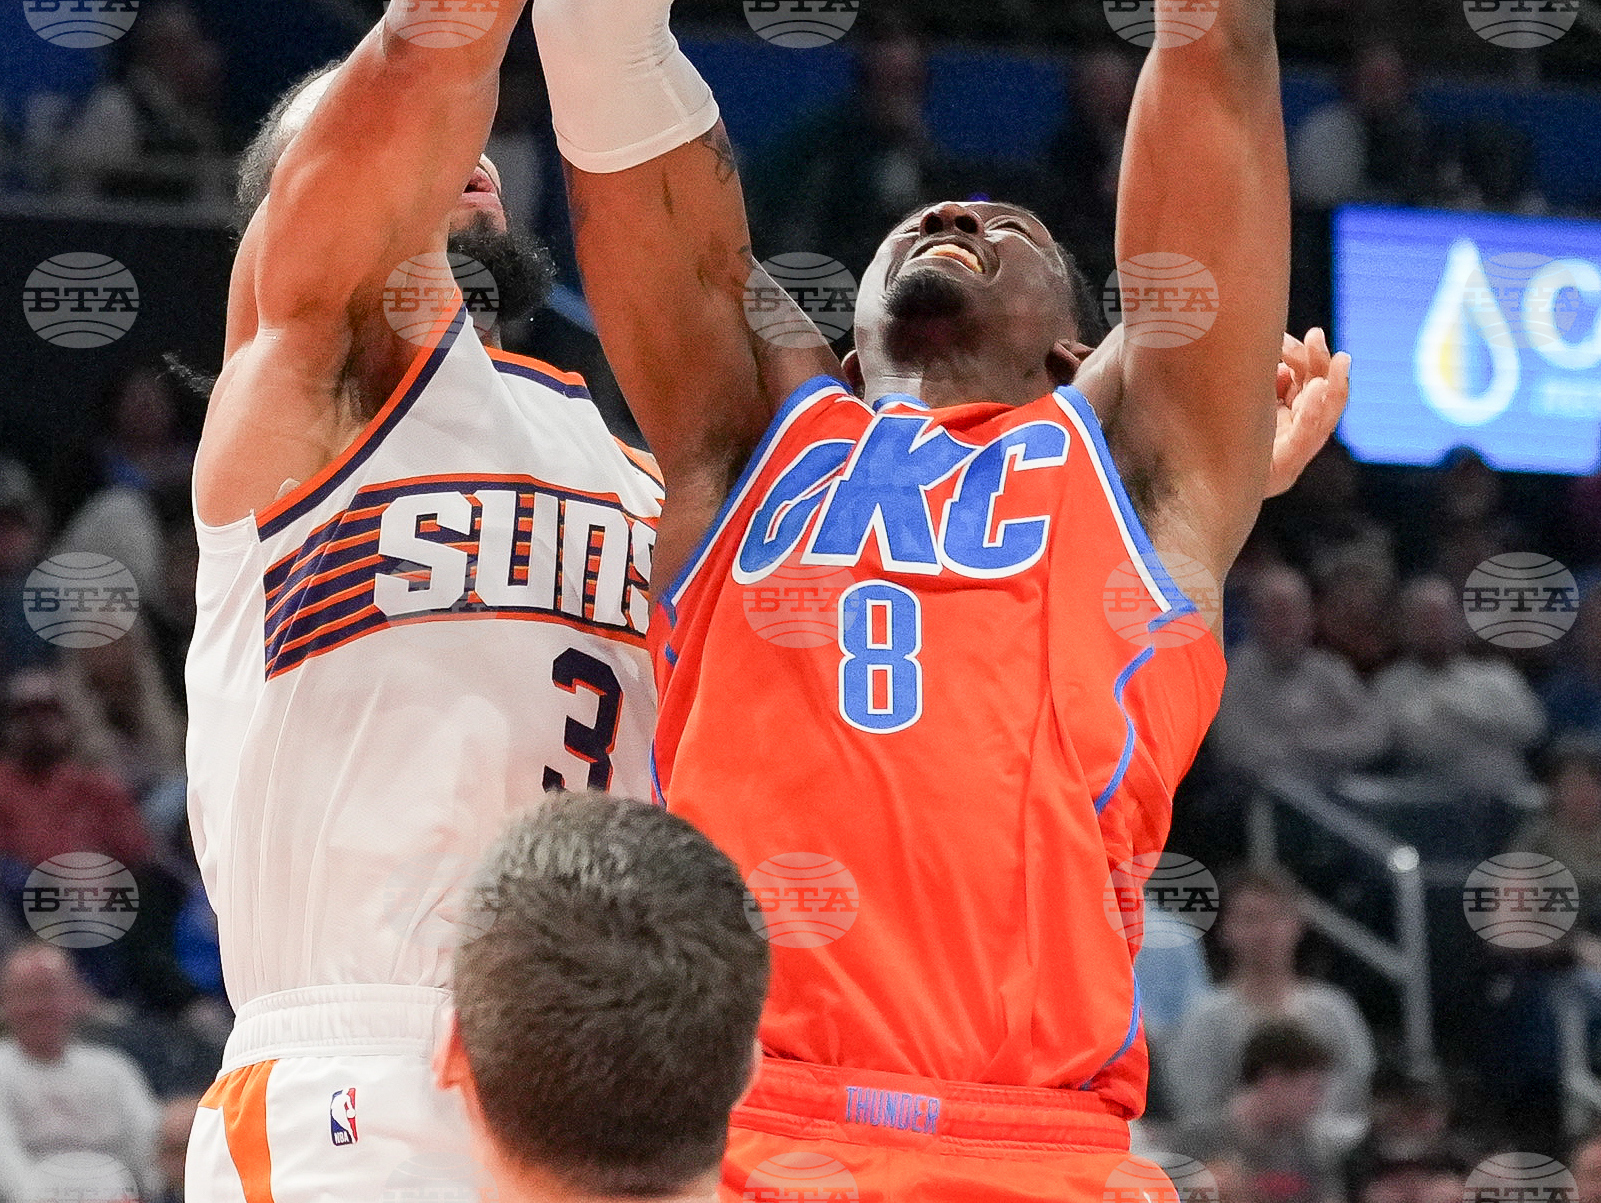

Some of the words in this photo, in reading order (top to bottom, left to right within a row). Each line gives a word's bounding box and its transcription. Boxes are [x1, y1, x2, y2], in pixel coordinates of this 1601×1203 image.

[731, 412, 1071, 584] OKC
[541, 647, 624, 794] 3
[838, 579, 923, 734] 8
[845, 1085, 941, 1135] THUNDER
